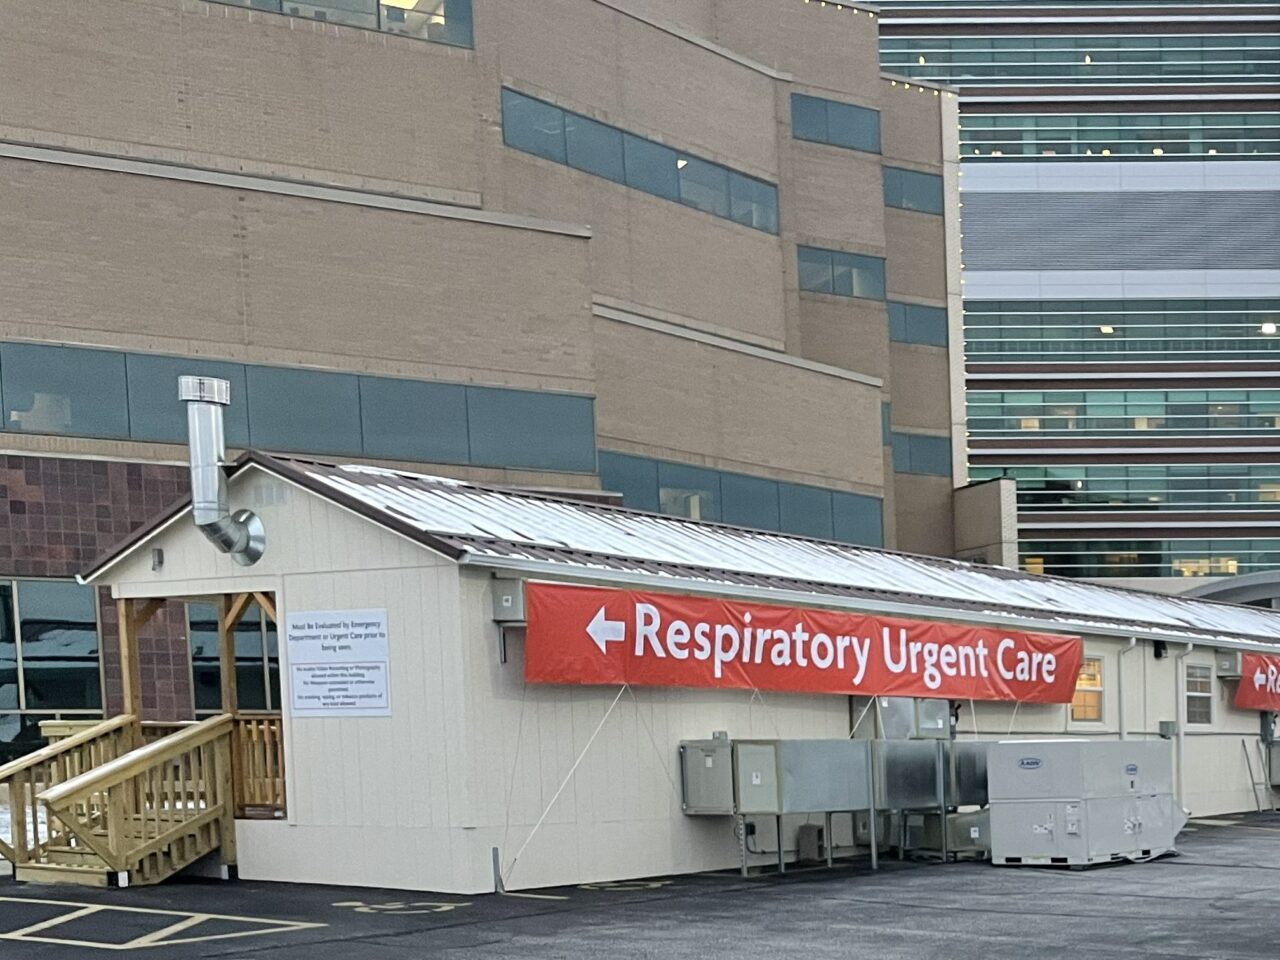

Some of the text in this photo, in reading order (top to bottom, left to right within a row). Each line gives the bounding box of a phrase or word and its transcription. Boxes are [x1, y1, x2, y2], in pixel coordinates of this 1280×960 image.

[330, 632, 349, 641] Urgent
[350, 631, 363, 639] Care
[634, 602, 1056, 689] Respiratory Urgent Care
